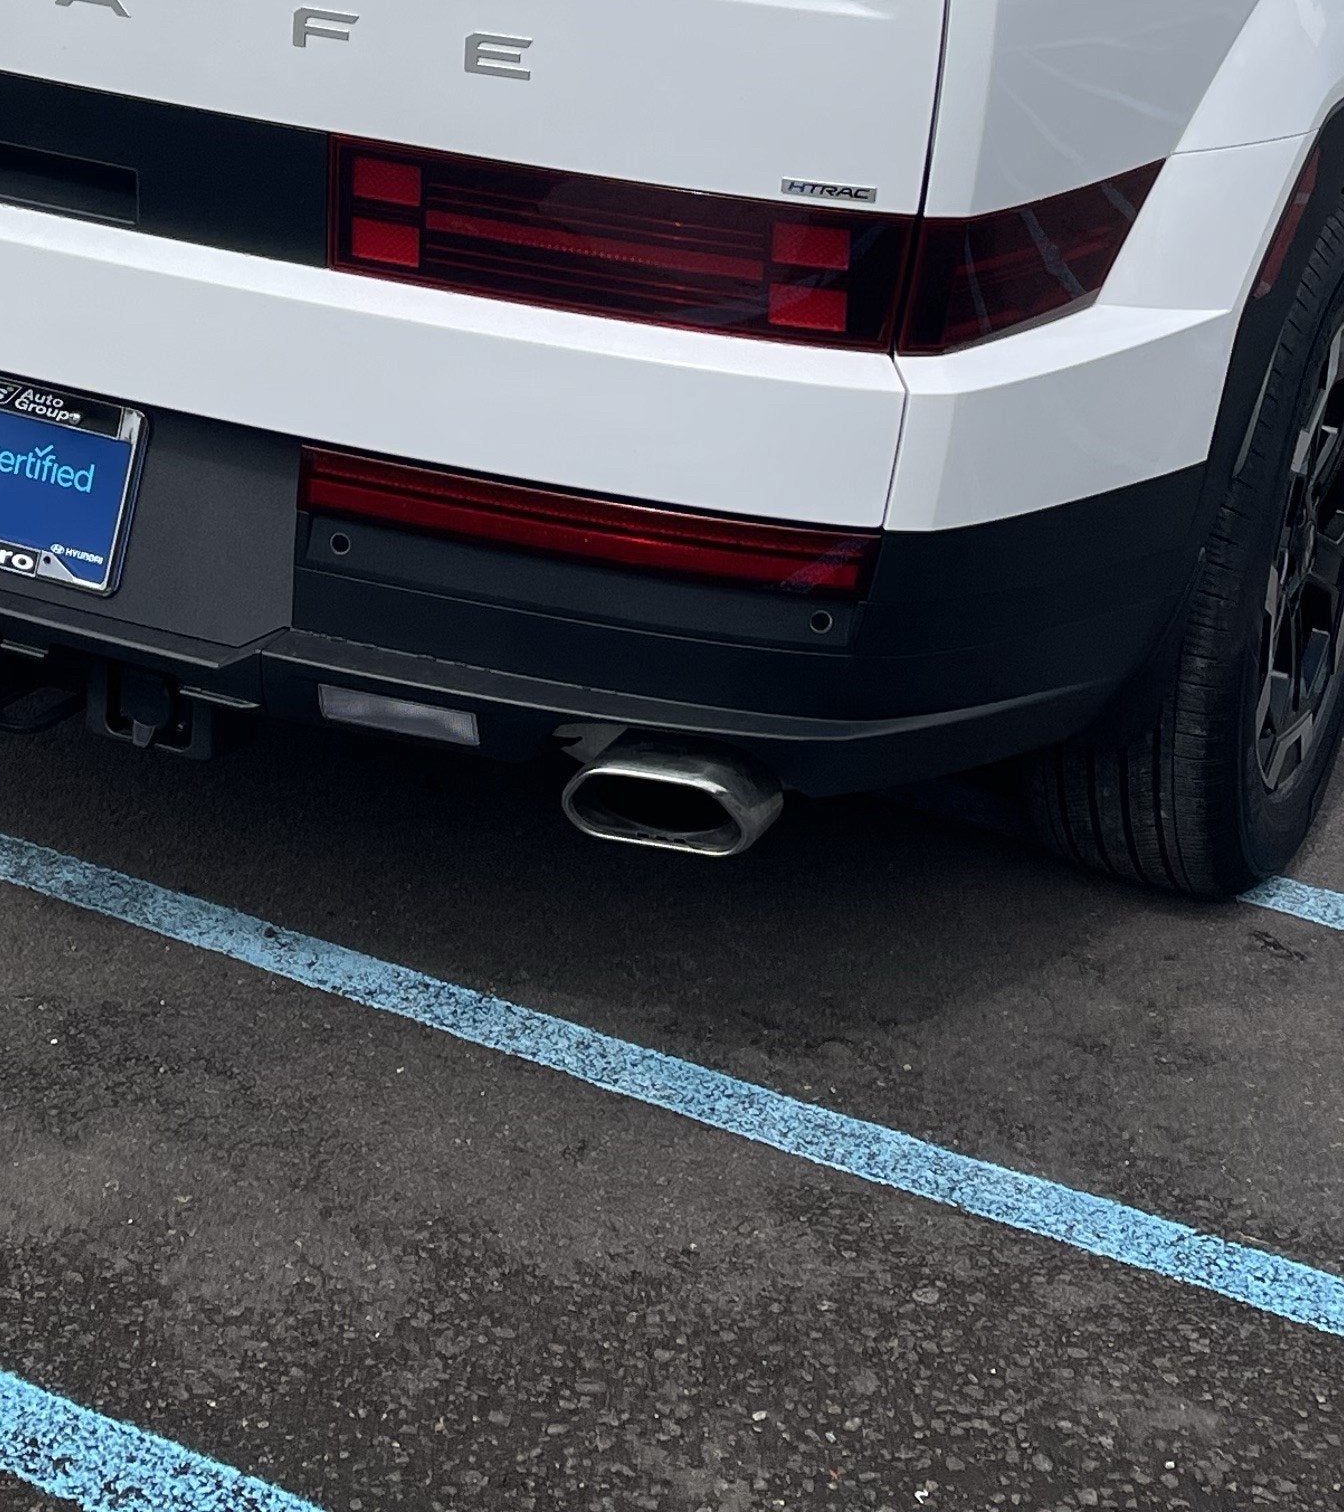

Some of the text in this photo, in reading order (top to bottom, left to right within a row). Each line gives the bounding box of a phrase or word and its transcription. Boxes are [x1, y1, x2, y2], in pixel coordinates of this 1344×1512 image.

[293, 7, 532, 81] FE
[788, 180, 870, 200] HTRAC
[20, 388, 65, 409] Auto
[14, 398, 70, 422] Group
[65, 547, 103, 565] HYUNDAI
